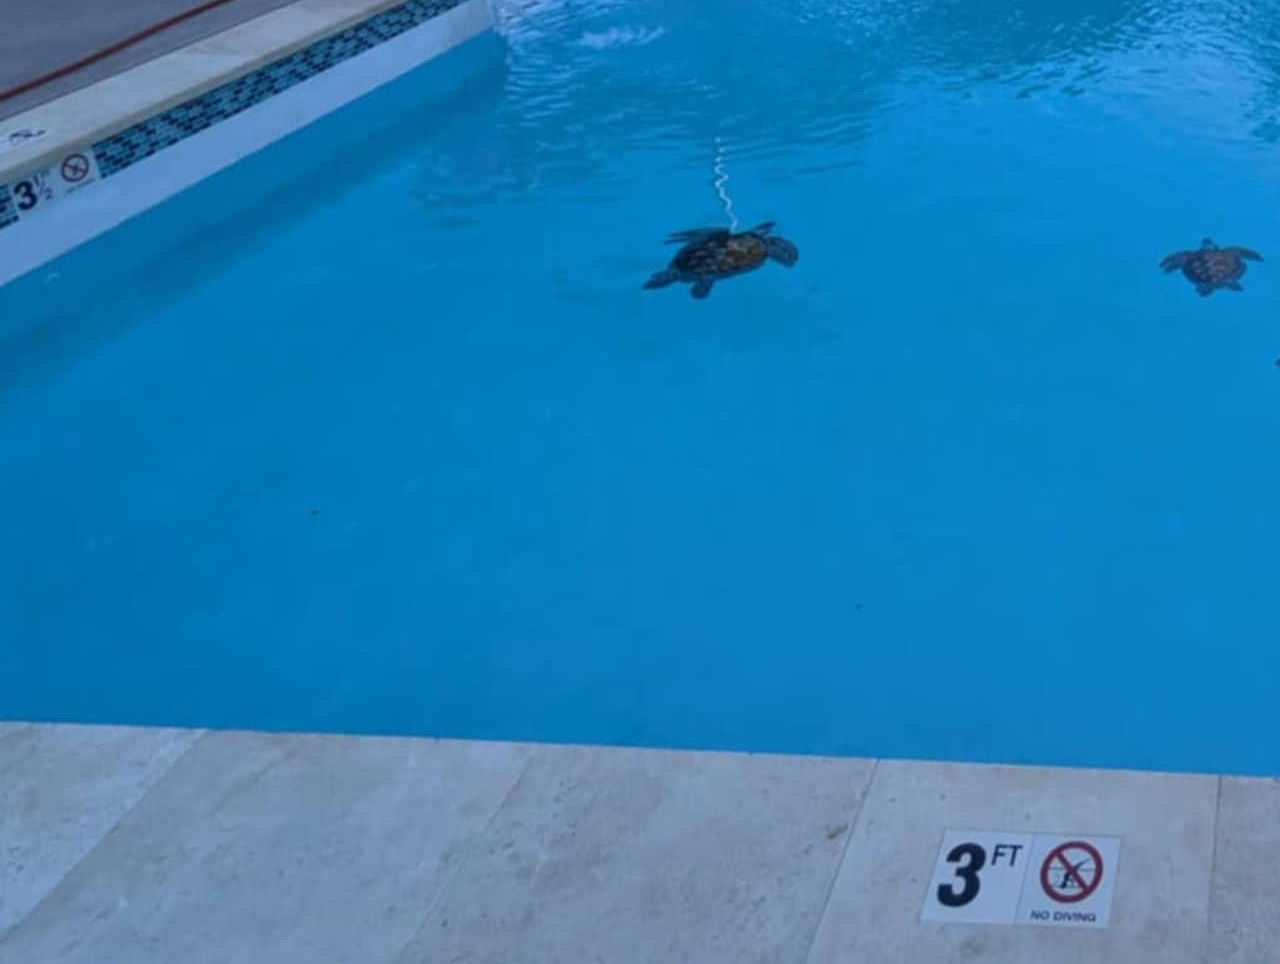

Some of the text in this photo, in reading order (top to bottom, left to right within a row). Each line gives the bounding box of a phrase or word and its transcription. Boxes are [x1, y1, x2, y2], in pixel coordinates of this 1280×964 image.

[13, 180, 38, 211] 3
[936, 842, 1023, 908] 3 FT
[1030, 909, 1097, 923] NO DIVING
